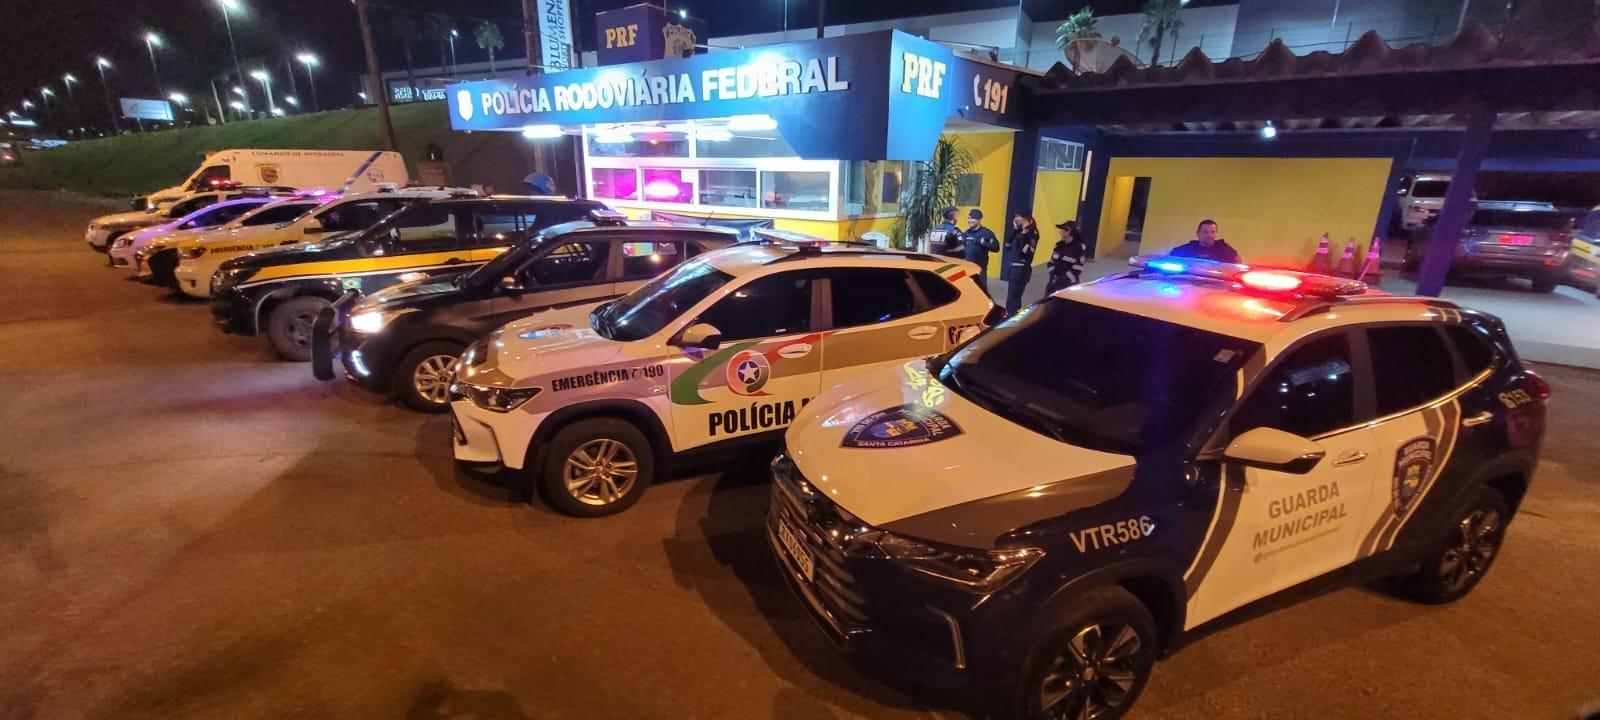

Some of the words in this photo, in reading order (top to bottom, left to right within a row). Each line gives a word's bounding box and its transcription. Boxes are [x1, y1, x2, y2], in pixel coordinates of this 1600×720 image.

[605, 24, 638, 49] PRF
[481, 82, 552, 116] POLÍCIA
[553, 68, 696, 112] RODOVIÁRIA
[701, 56, 849, 101] FEDERAL
[901, 51, 946, 99] PRF
[983, 78, 1008, 114] 191
[551, 368, 630, 392] EMERGÊNCIA
[642, 364, 664, 378] 190
[708, 400, 796, 437] POLÍCIA
[857, 440, 886, 448] SANTA
[1268, 481, 1340, 519] GUARDA
[1068, 515, 1156, 553] VTR586
[1252, 503, 1347, 549] MUNICIPAL
